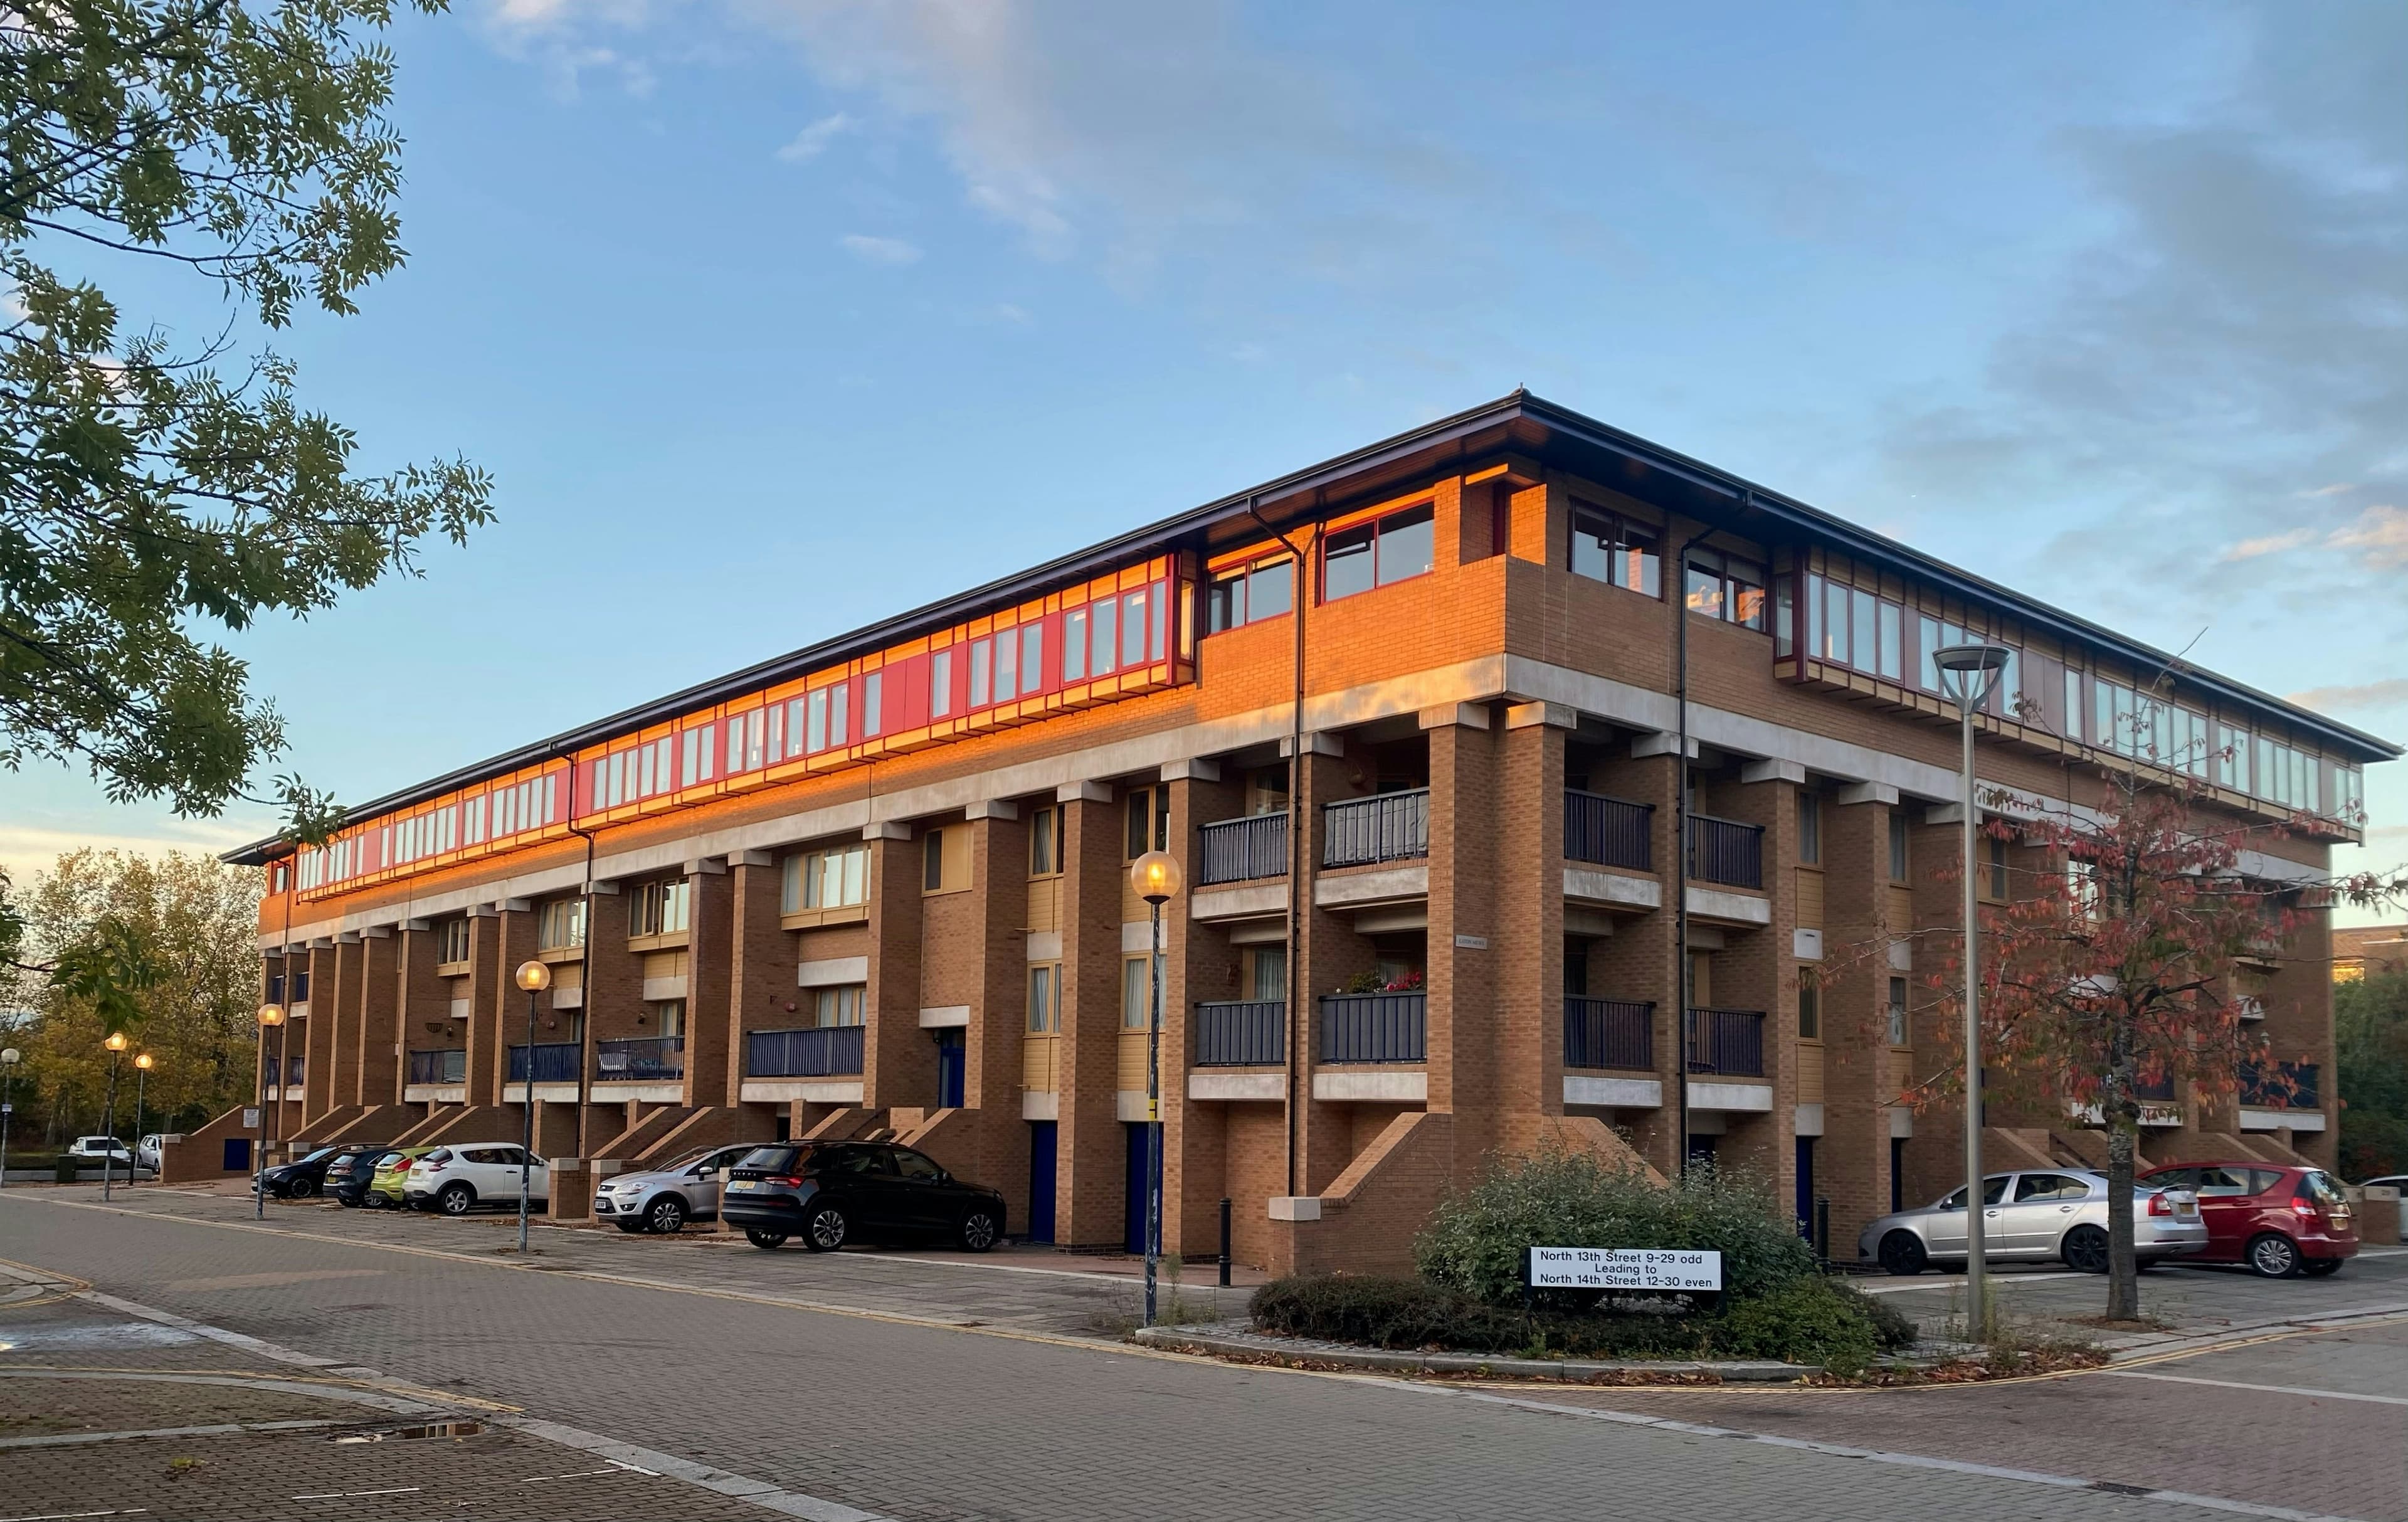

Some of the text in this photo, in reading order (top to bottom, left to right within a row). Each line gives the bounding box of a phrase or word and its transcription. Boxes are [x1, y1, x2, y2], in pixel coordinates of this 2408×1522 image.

[1541, 1250, 1702, 1264] North 13th Street 9-29 odd
[1595, 1263, 1657, 1276] Leading to
[1540, 1274, 1712, 1287] North 14th Street 12-30 even
